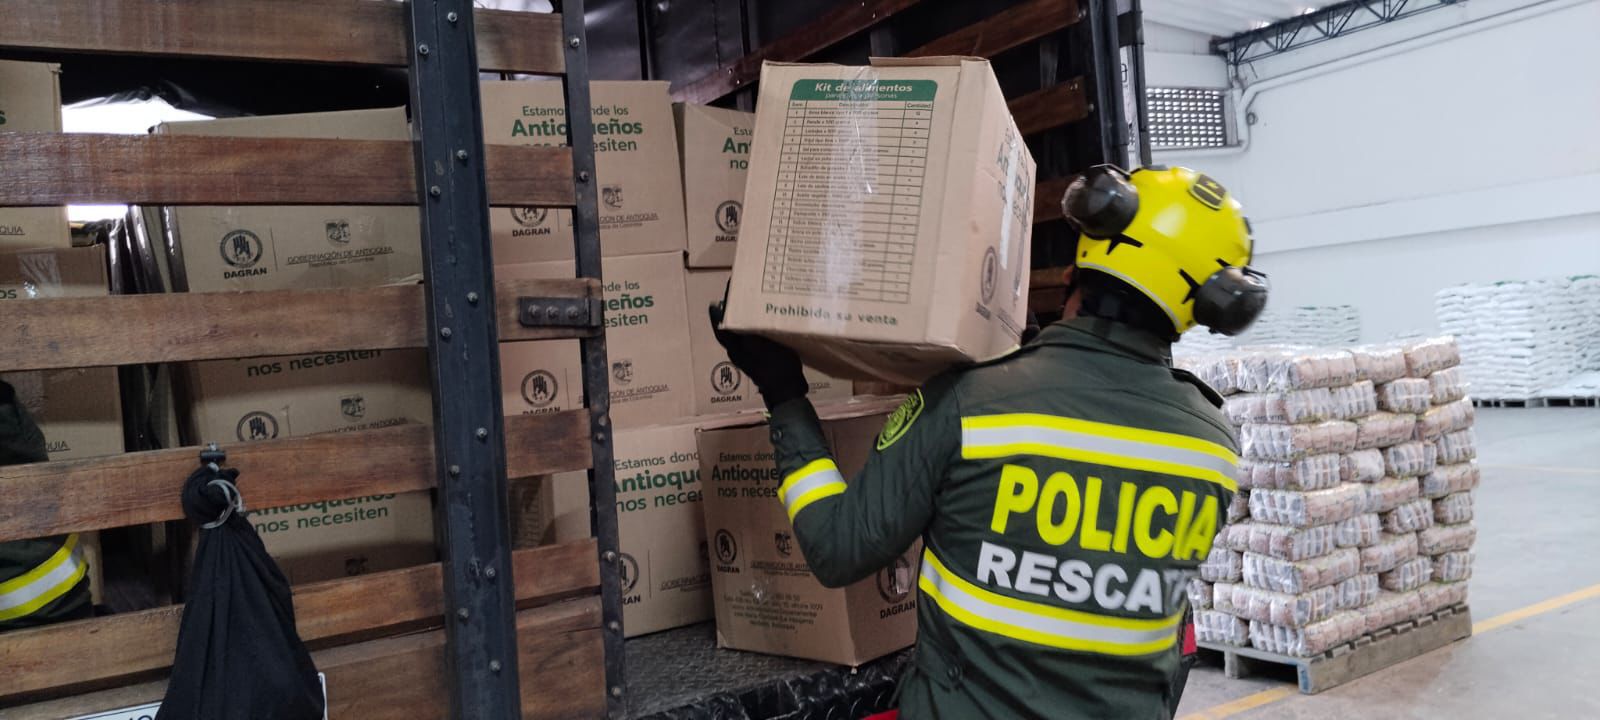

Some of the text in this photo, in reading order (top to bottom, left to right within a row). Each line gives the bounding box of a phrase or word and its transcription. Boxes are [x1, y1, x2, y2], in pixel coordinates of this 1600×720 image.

[815, 83, 832, 92] Kit
[854, 82, 913, 93] alimentos
[522, 104, 629, 117] Estamo nde los
[511, 117, 643, 138] Antioeños
[593, 138, 638, 153] esiten
[730, 159, 750, 170] no
[512, 227, 551, 237] DAGRAN
[224, 267, 267, 280] DAGRAN
[602, 280, 641, 292] nde los
[604, 313, 649, 328] esiten
[765, 303, 831, 320] Prohibida
[857, 312, 898, 325] venta
[247, 349, 382, 377] nos necesiten
[711, 394, 742, 403] DAGRAN
[614, 451, 700, 471] Estamos don
[719, 452, 776, 463] Estamos dond
[614, 468, 700, 493] ntioqu
[711, 464, 778, 486] Antioque
[654, 489, 703, 508] neces
[717, 486, 778, 499] nos neces
[255, 506, 389, 534] nos necesiten
[990, 463, 1219, 562] POLICIA
[880, 599, 916, 620] DAGRAN
